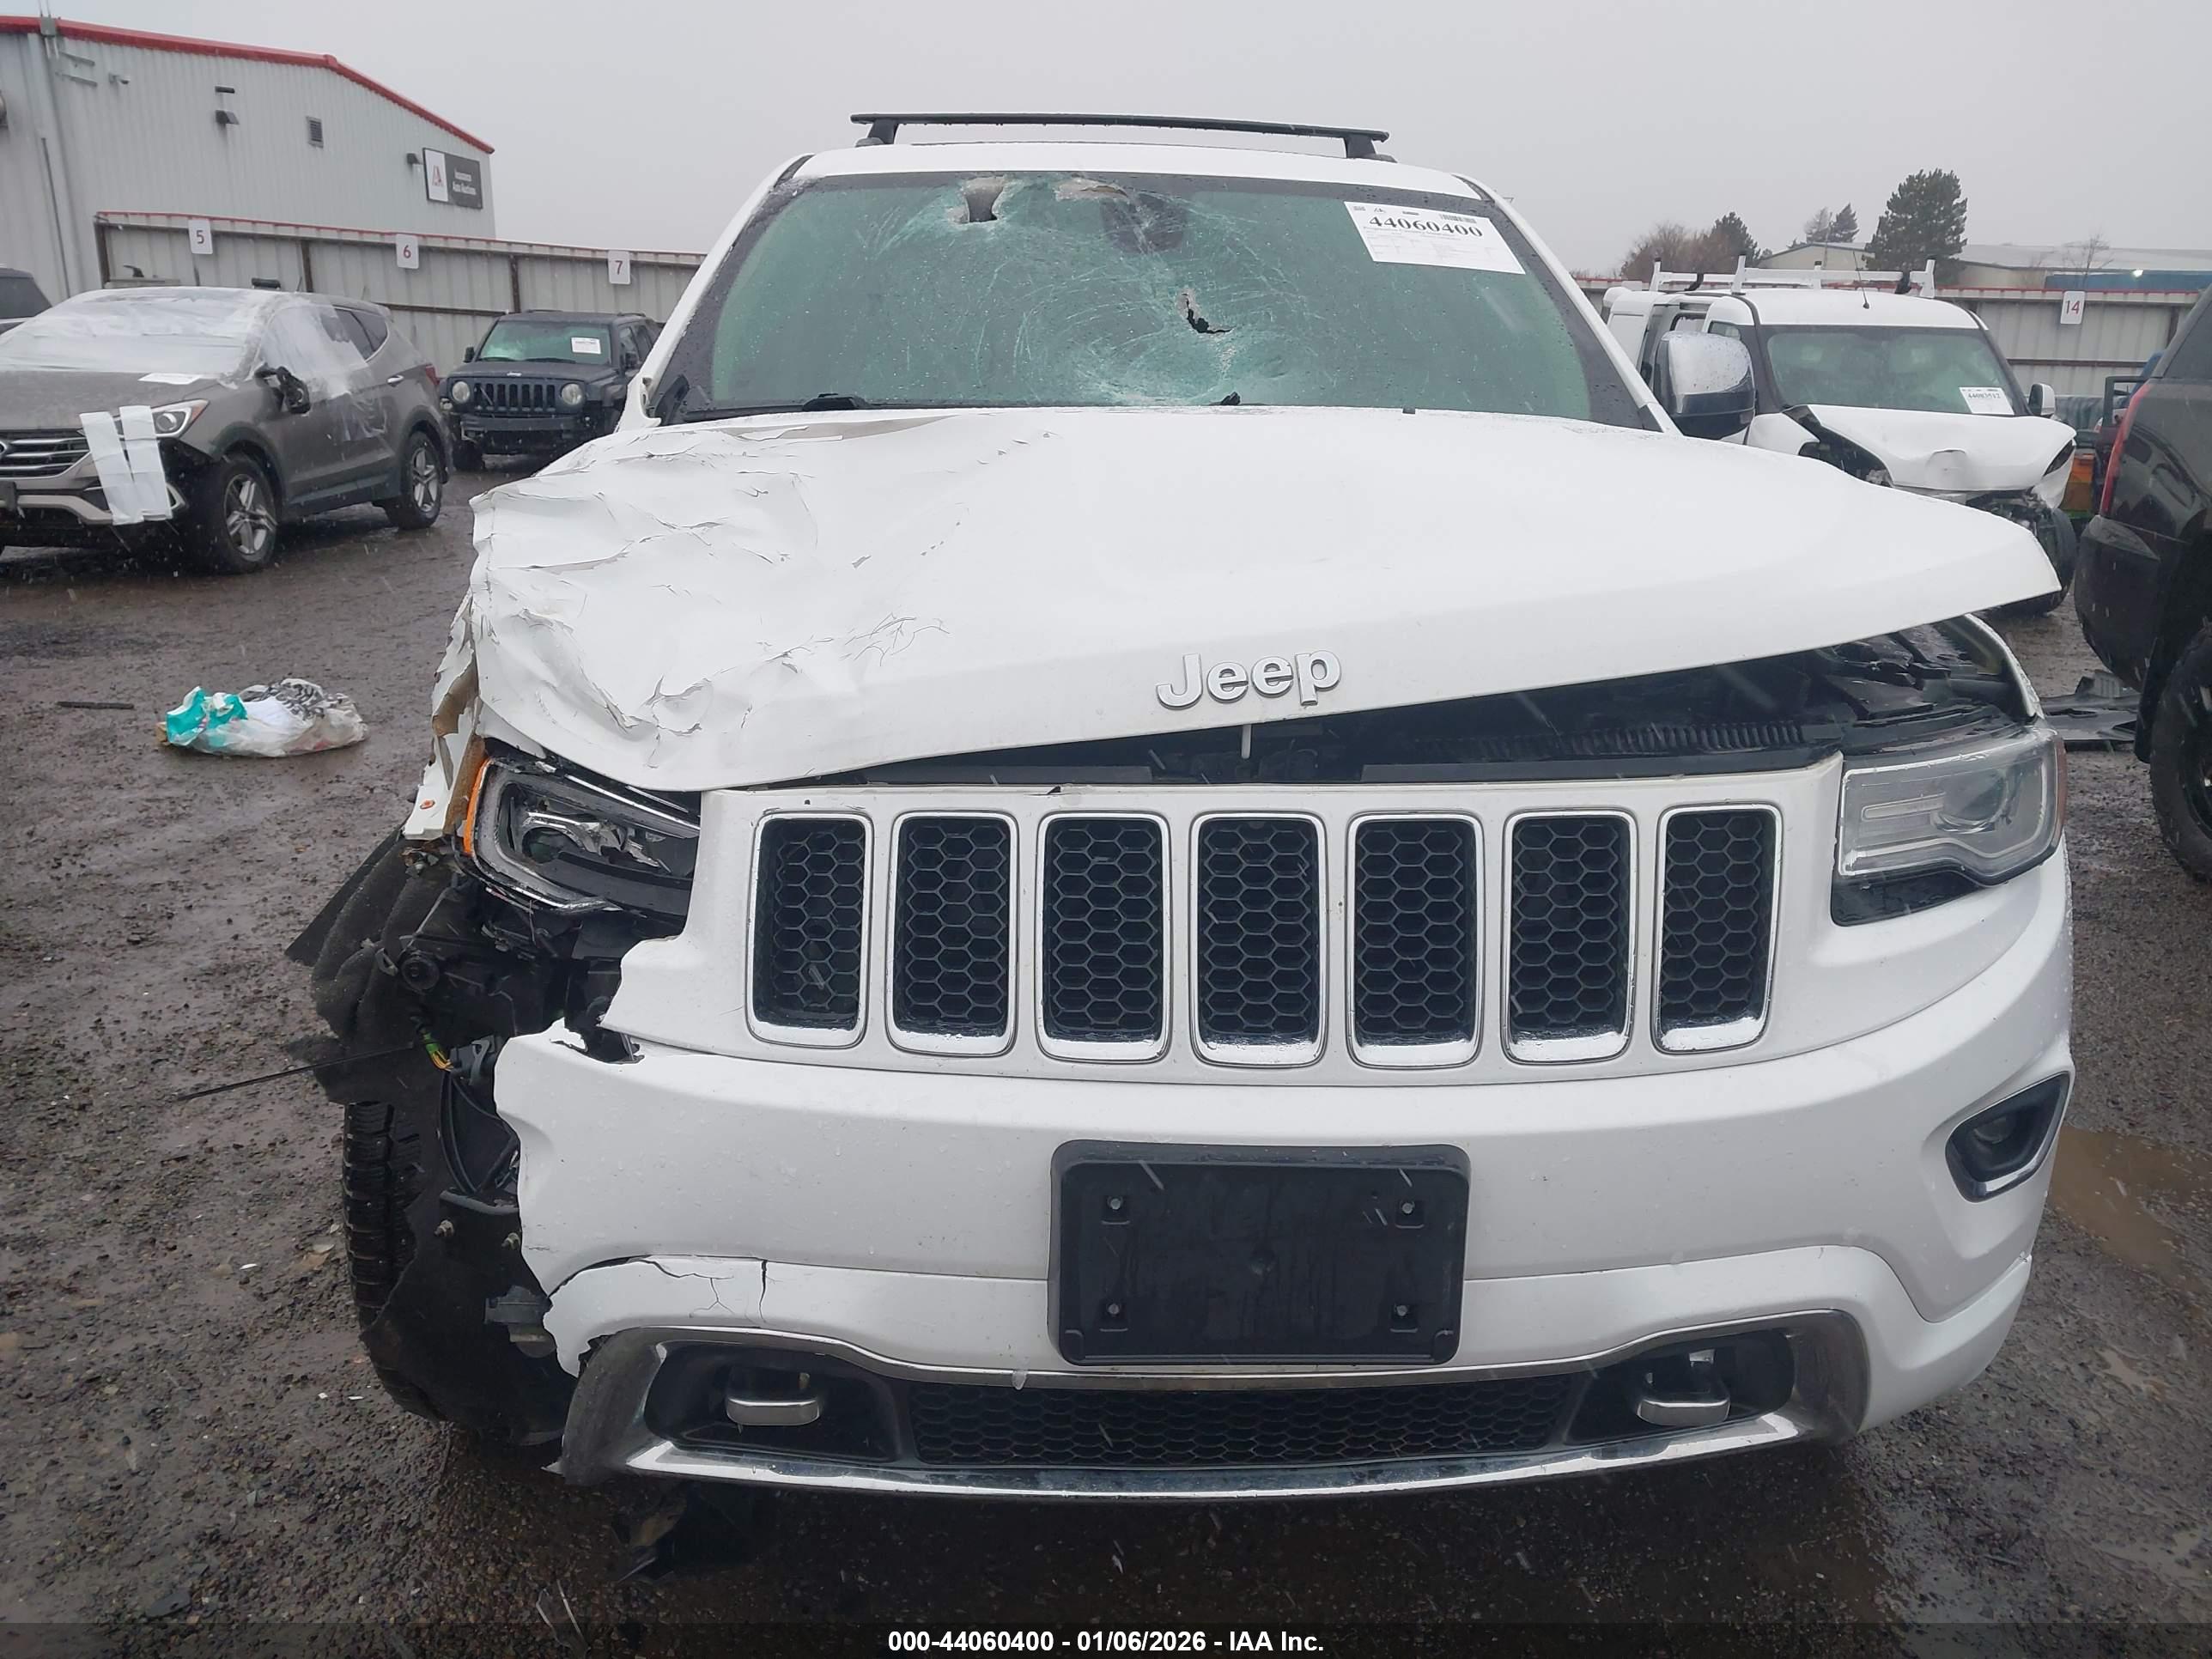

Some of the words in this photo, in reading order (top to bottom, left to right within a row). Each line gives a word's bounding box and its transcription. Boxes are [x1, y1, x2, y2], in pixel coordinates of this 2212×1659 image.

[1368, 216, 1484, 238] 44060400
[196, 229, 205, 245] 5
[403, 244, 412, 259] 6
[614, 259, 623, 276] 7
[2065, 300, 2081, 315] 14
[1155, 649, 1342, 710] Jeep
